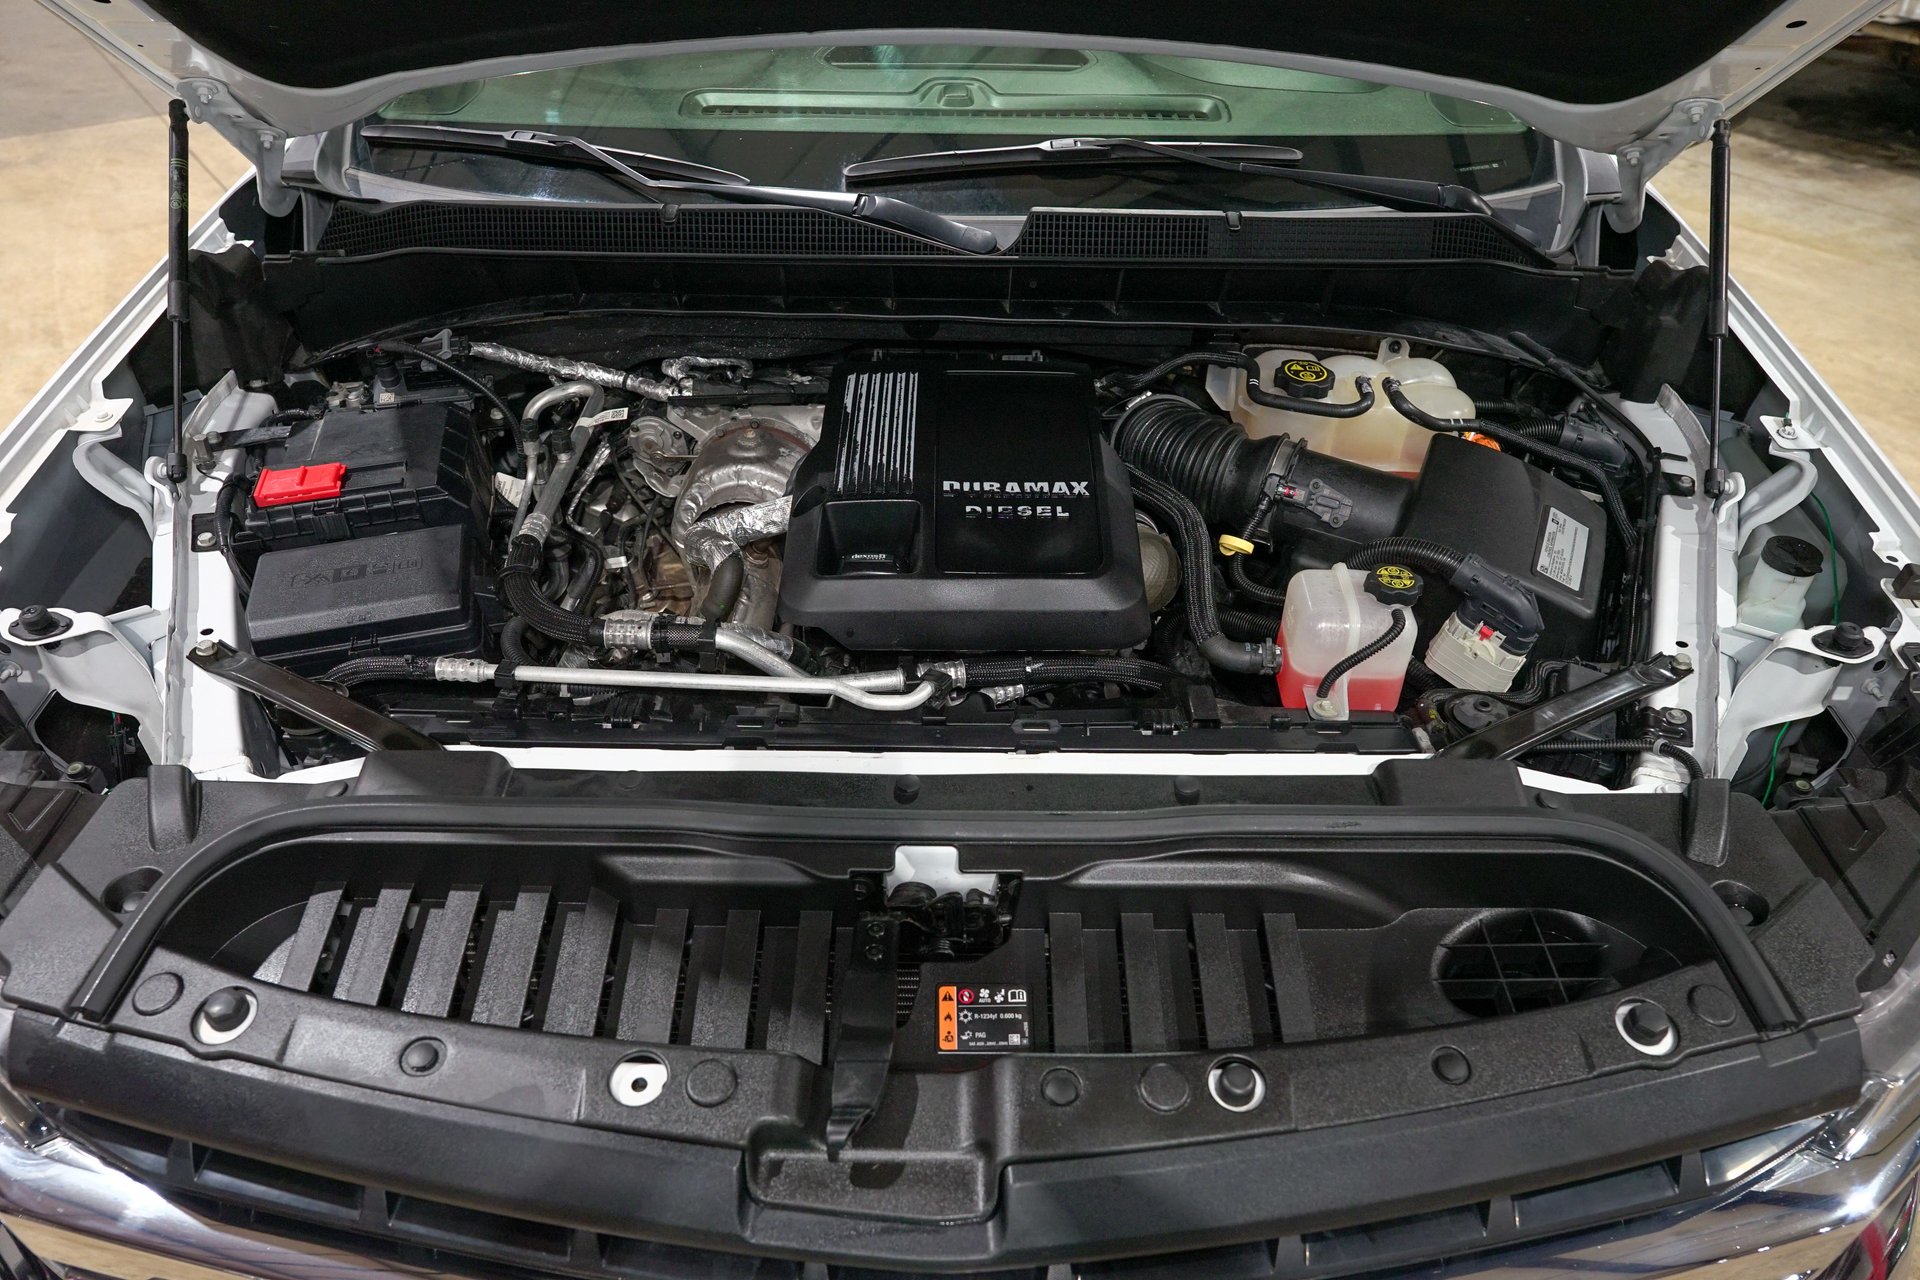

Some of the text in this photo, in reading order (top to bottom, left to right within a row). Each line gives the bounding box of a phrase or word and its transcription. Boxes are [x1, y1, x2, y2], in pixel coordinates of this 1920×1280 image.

[942, 480, 1090, 497] DURAMAX
[965, 505, 1070, 518] DIESEL
[974, 1012, 998, 1021] R-1234yf
[1015, 1012, 1022, 1020] kg
